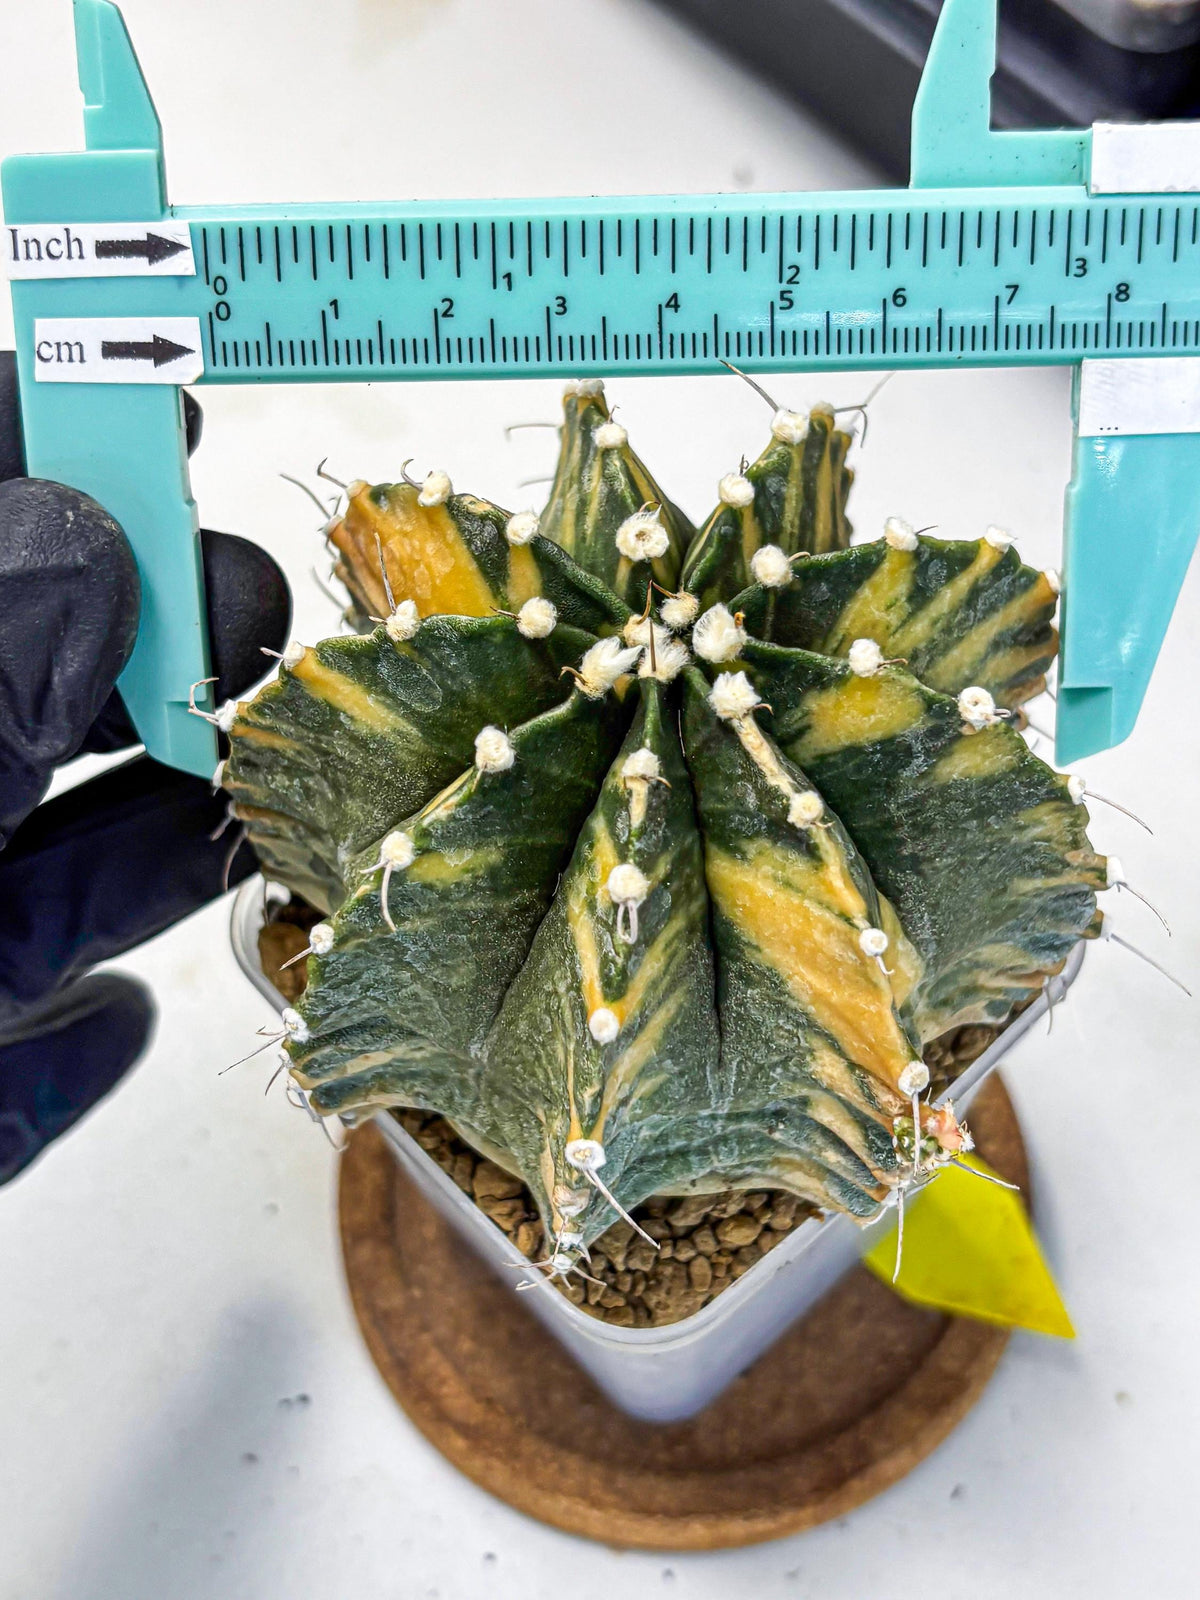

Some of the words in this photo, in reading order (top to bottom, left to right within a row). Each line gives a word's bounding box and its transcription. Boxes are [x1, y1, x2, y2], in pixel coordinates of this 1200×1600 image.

[9, 227, 85, 262] Inch
[785, 264, 801, 285] 2
[1072, 257, 1089, 278] 3
[213, 275, 229, 297] 0
[502, 272, 514, 292] 1
[1113, 282, 1131, 304] 8
[554, 295, 569, 316] 3
[664, 292, 682, 314] 4
[779, 290, 794, 311] 5
[892, 288, 908, 308] 6
[1004, 284, 1020, 306] 7
[215, 300, 231, 322] 0
[328, 298, 340, 320] 1
[440, 297, 455, 319] 2
[36, 339, 87, 363] cm
